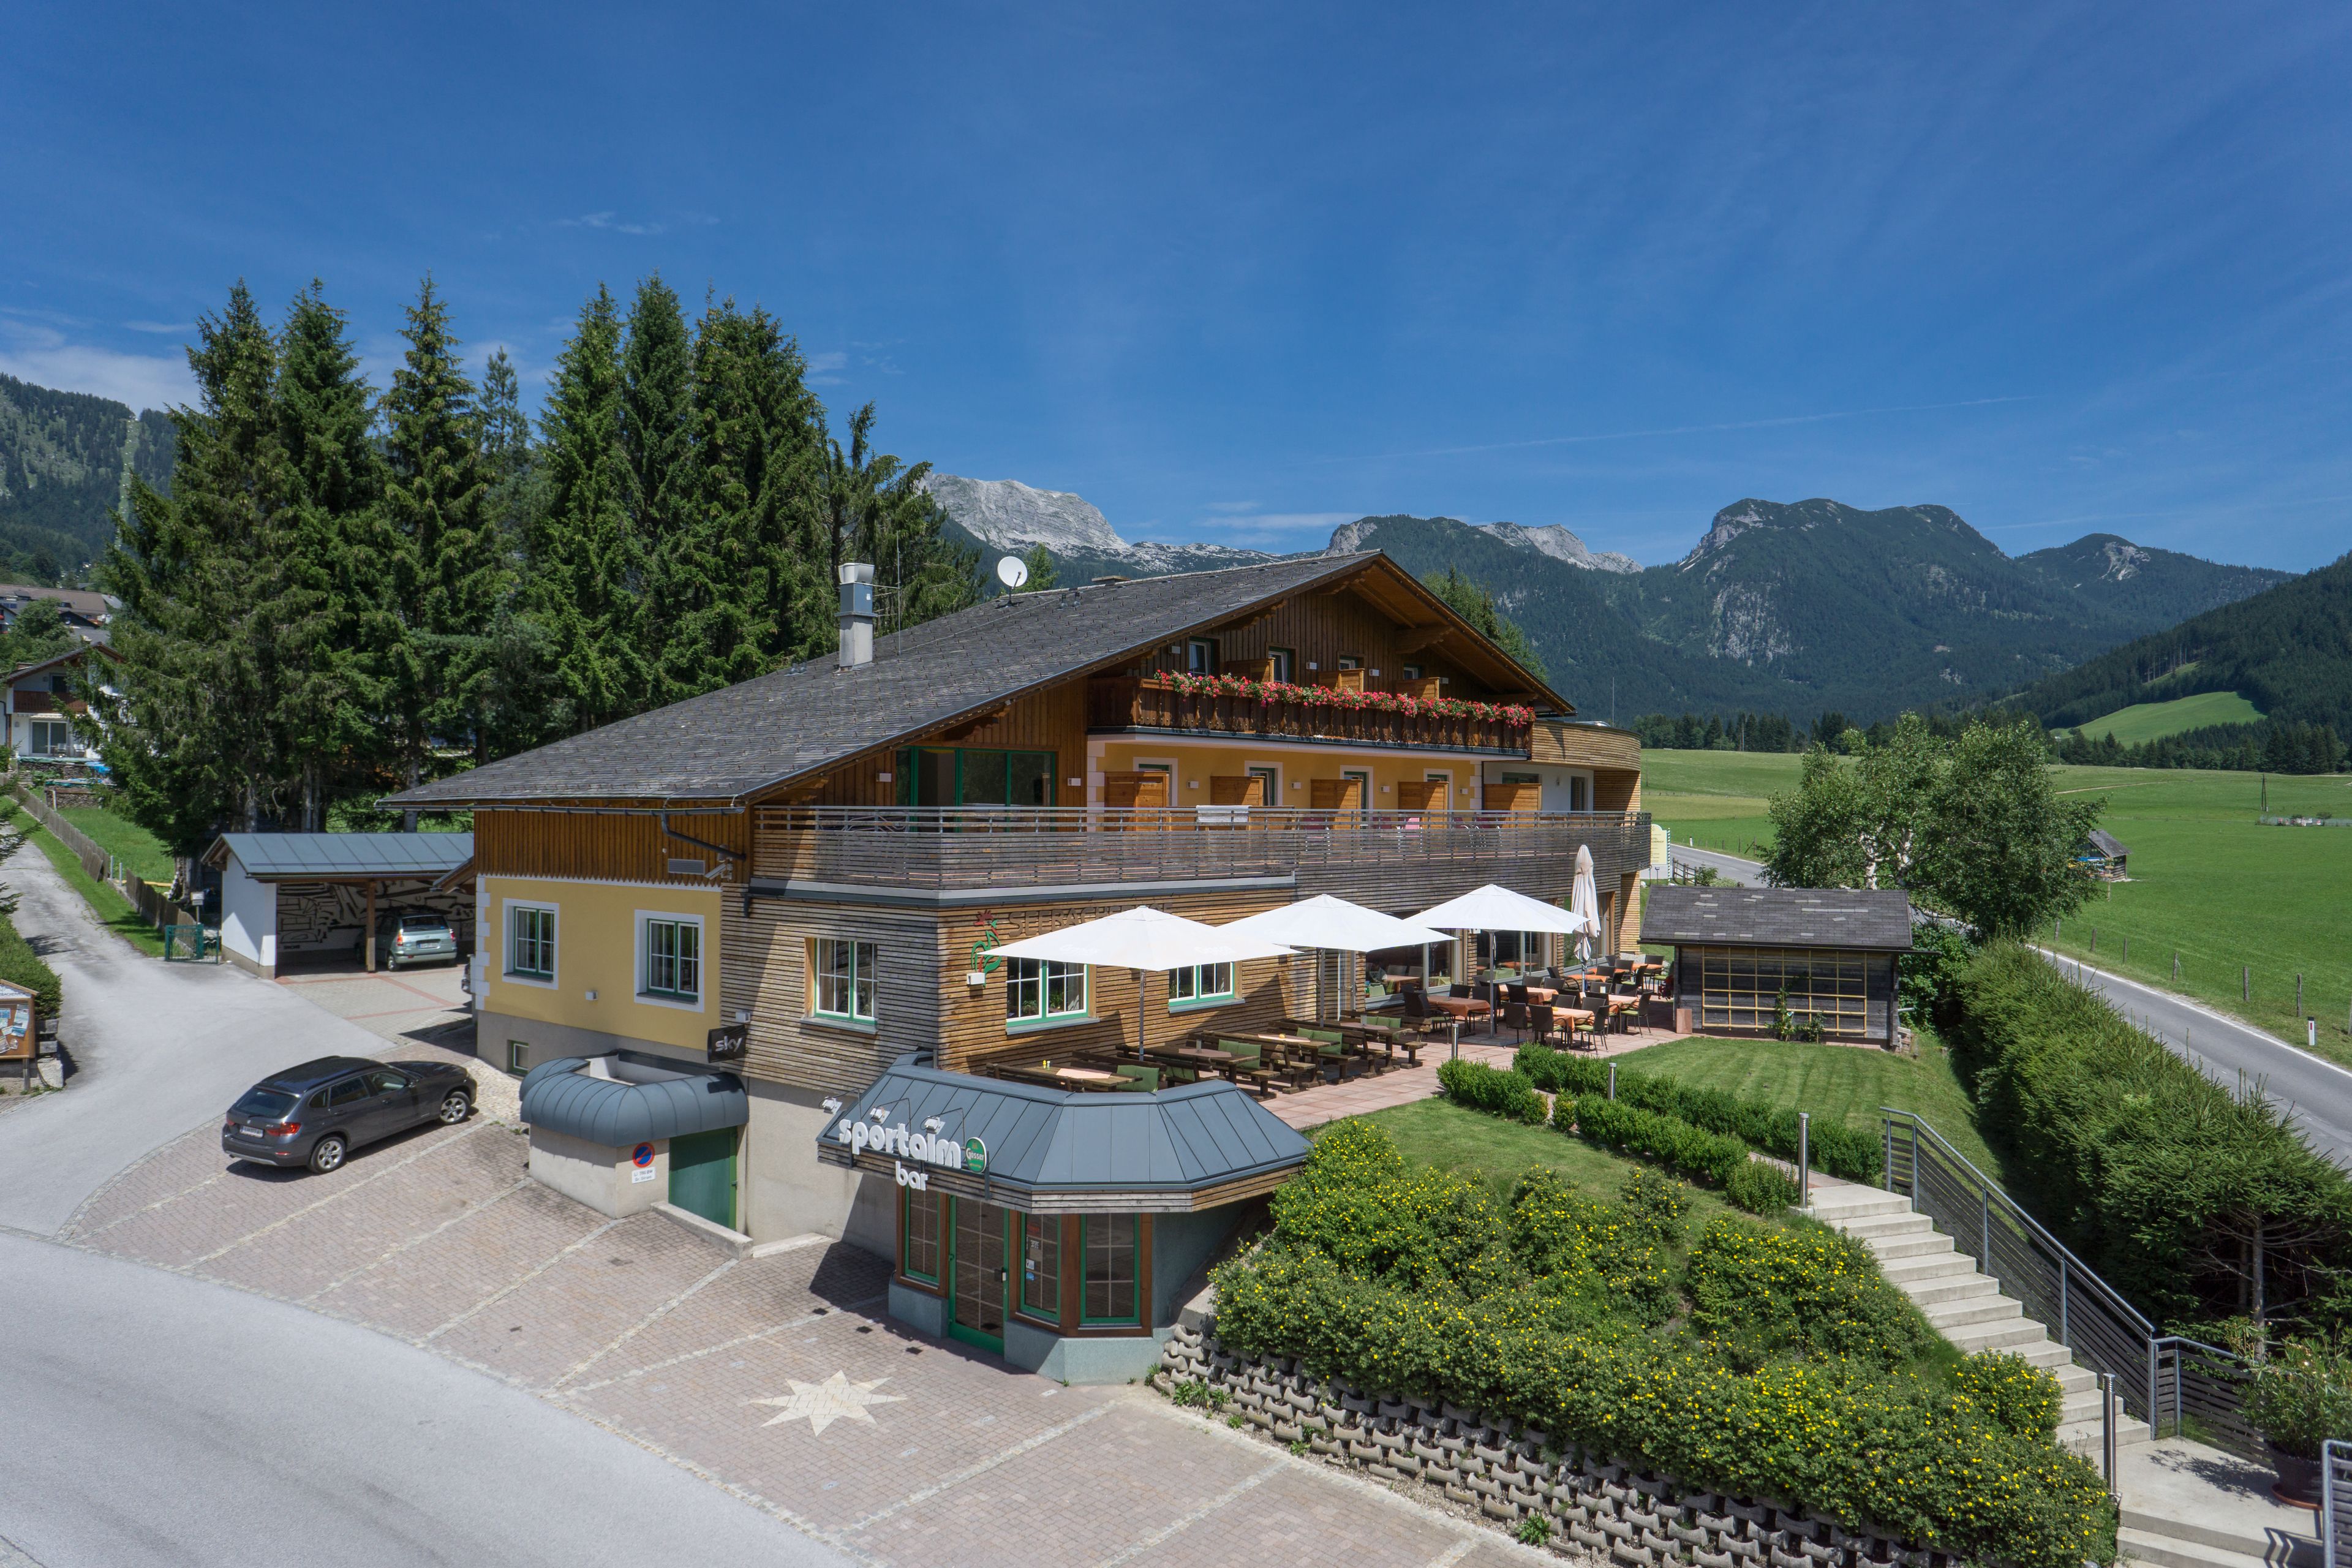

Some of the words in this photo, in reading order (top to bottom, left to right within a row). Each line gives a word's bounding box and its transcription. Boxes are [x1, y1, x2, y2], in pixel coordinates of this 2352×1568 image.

[715, 1036, 742, 1052] sky
[839, 1119, 961, 1169] sportalm
[895, 1161, 929, 1191] bar
